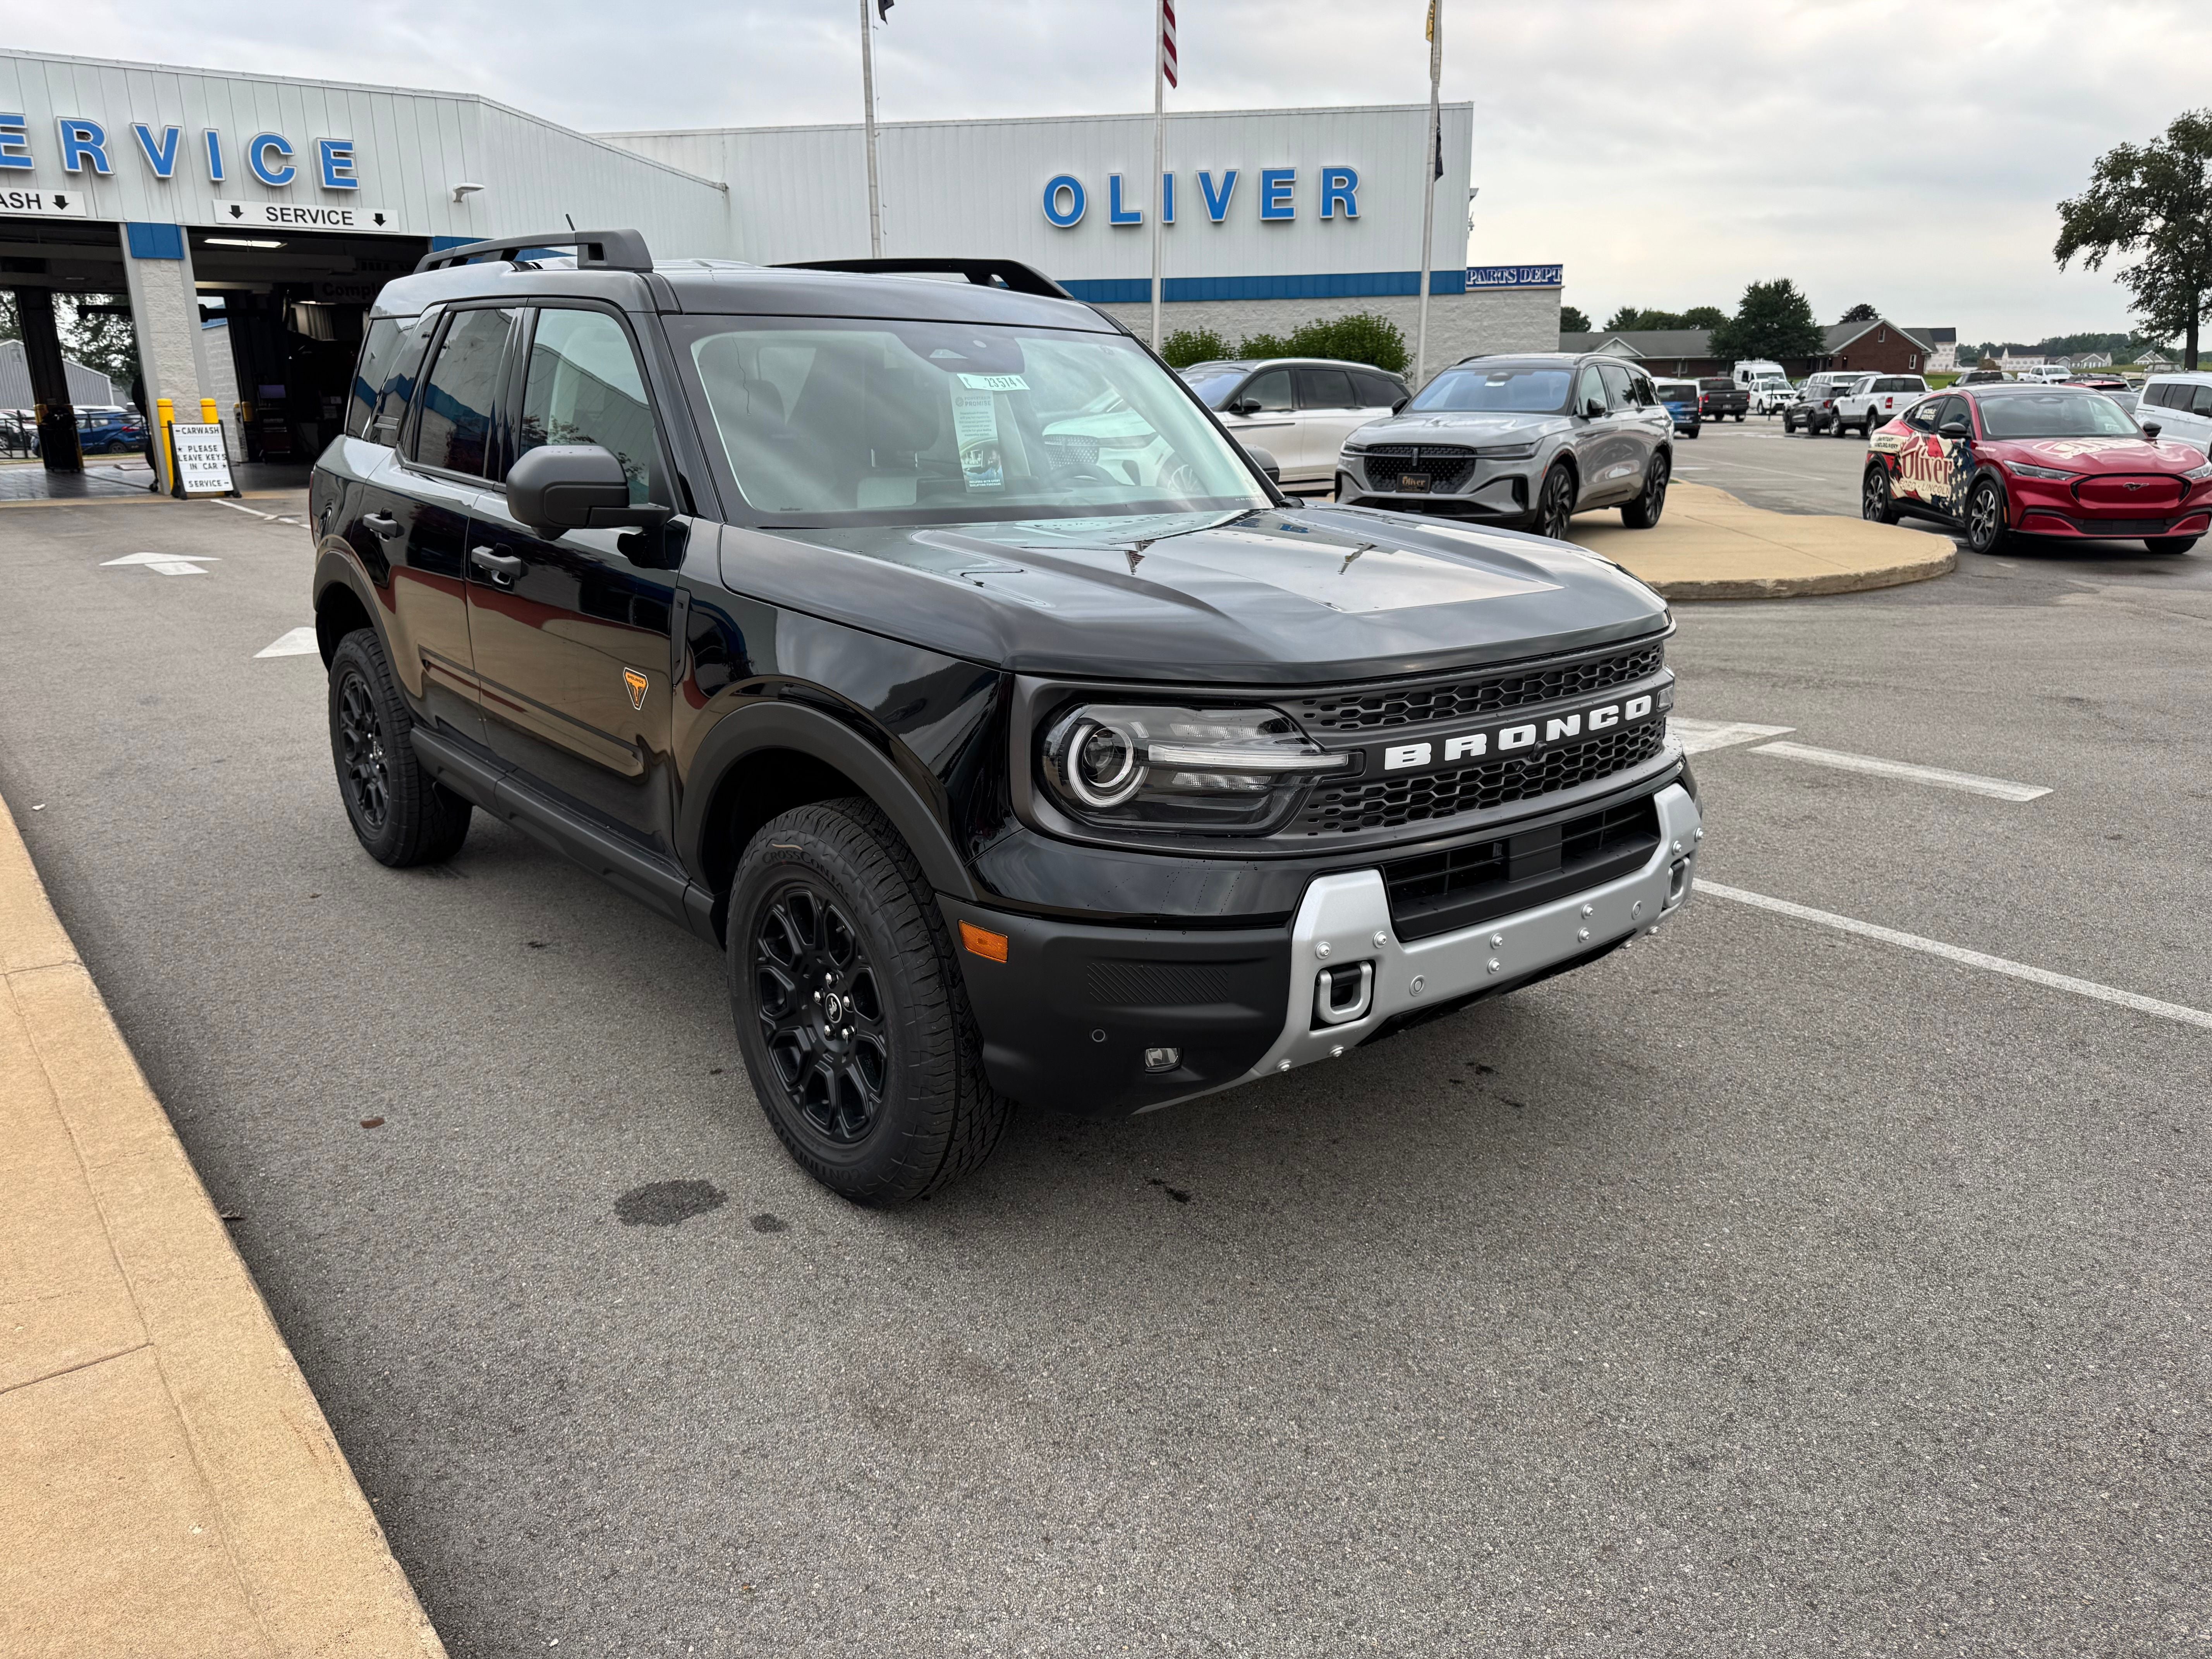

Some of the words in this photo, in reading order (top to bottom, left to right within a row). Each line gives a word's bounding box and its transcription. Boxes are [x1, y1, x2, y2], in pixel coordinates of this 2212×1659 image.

[1042, 165, 1361, 228] OLIVER
[266, 206, 354, 225] SERVICE
[1466, 268, 1517, 285] PARTS
[1520, 267, 1562, 283] DEPT
[323, 283, 378, 299] Compl
[985, 377, 1017, 387] 23574
[1902, 436, 1953, 484] Oliver
[1922, 484, 1951, 495] LINCOLN
[1384, 695, 1651, 770] BRONCO
